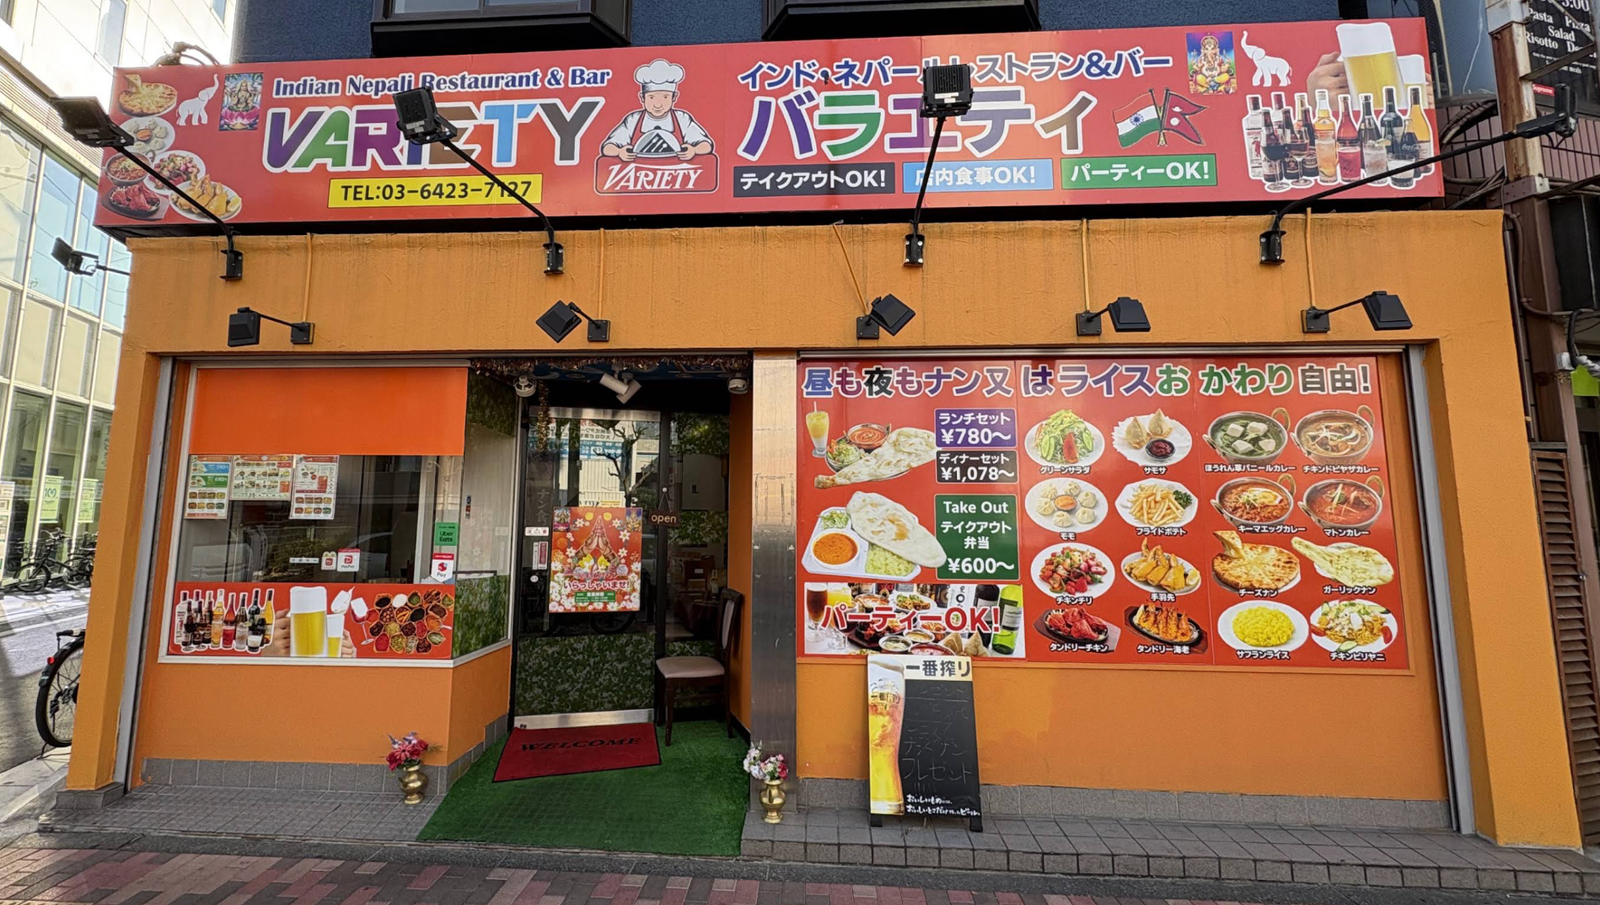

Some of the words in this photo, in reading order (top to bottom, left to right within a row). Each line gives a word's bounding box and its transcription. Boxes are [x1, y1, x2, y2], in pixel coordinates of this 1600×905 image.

[1528, 8, 1554, 24] Pasta
[1547, 25, 1576, 42] Salad
[1525, 31, 1559, 49] Risotto
[274, 78, 339, 96] Indian
[347, 75, 413, 97] Nepali
[421, 70, 540, 90] Restaurant
[547, 69, 562, 86] &
[571, 68, 611, 87] Bar
[740, 90, 1095, 157] バラエティ
[603, 163, 703, 190] VARIETY
[1070, 160, 1210, 182] パーティーOK!
[740, 171, 887, 190] テイクアウトOK!
[939, 412, 1011, 425] ランチセット
[939, 453, 1010, 465] ディナーセット
[1040, 466, 1090, 475] グリーンサラダ
[1144, 466, 1166, 475] サモサ
[943, 501, 976, 514] Take
[980, 501, 1009, 514] Out
[651, 513, 677, 524] open
[941, 520, 1012, 534] テイクアウト
[1136, 527, 1187, 536] フライドポテト
[1238, 524, 1306, 533] キーマエッグカレー
[1324, 528, 1369, 537] マトンカレー
[964, 536, 989, 550] 弁当
[563, 580, 630, 590] いらっしゃいませ!
[1323, 586, 1376, 595] ガーリックナン
[1151, 593, 1175, 602] 手羽先
[1239, 589, 1278, 597] チーズナン
[1056, 596, 1093, 605] チキンチリ
[820, 604, 1001, 632] パーティーOK!
[1050, 643, 1108, 652] タンドリーチキン
[1137, 644, 1190, 654] タンドリー海老
[1236, 650, 1290, 659] サフランライス
[1330, 652, 1385, 661] チキンビリヤニ
[906, 660, 971, 677] 一番搾り
[521, 737, 642, 752] WELCOME
